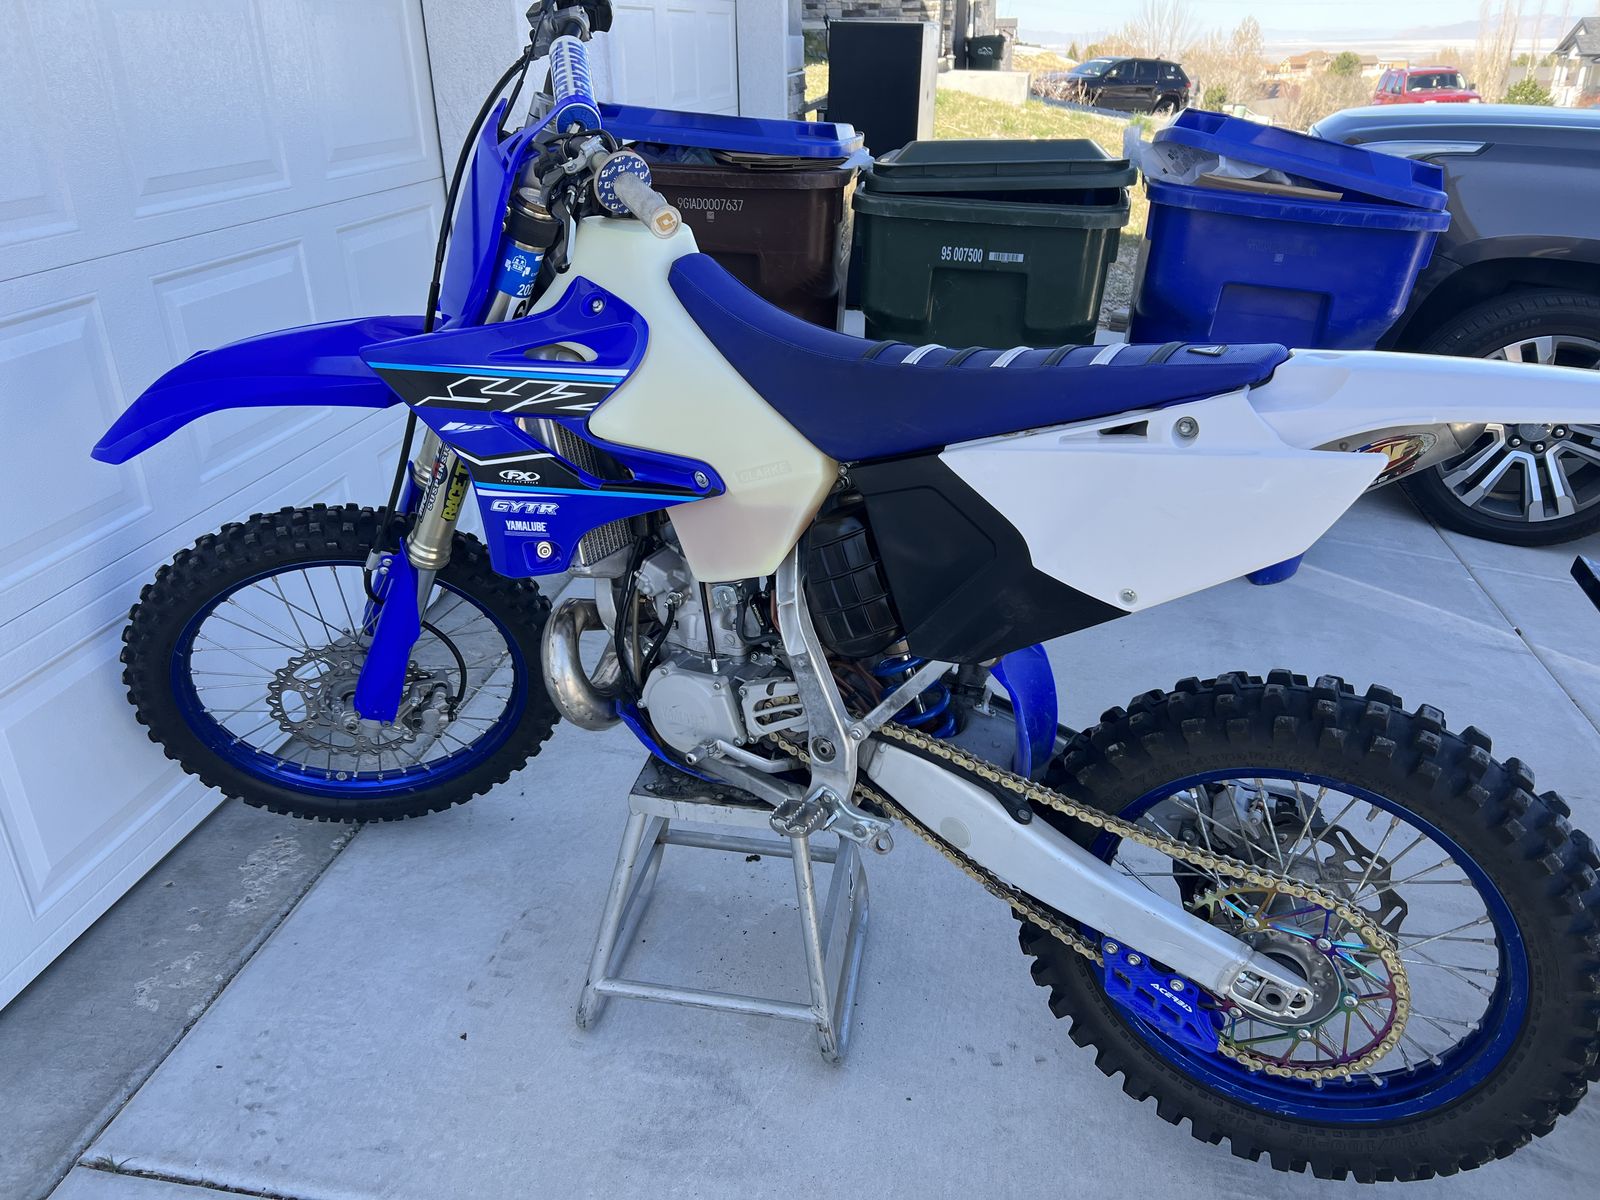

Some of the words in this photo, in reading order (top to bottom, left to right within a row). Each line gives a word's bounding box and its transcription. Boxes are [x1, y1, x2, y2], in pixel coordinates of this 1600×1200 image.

[941, 246, 952, 260] 95
[953, 247, 983, 263] 007500
[490, 499, 560, 515] GYTR
[505, 520, 548, 532] YAMALUBE
